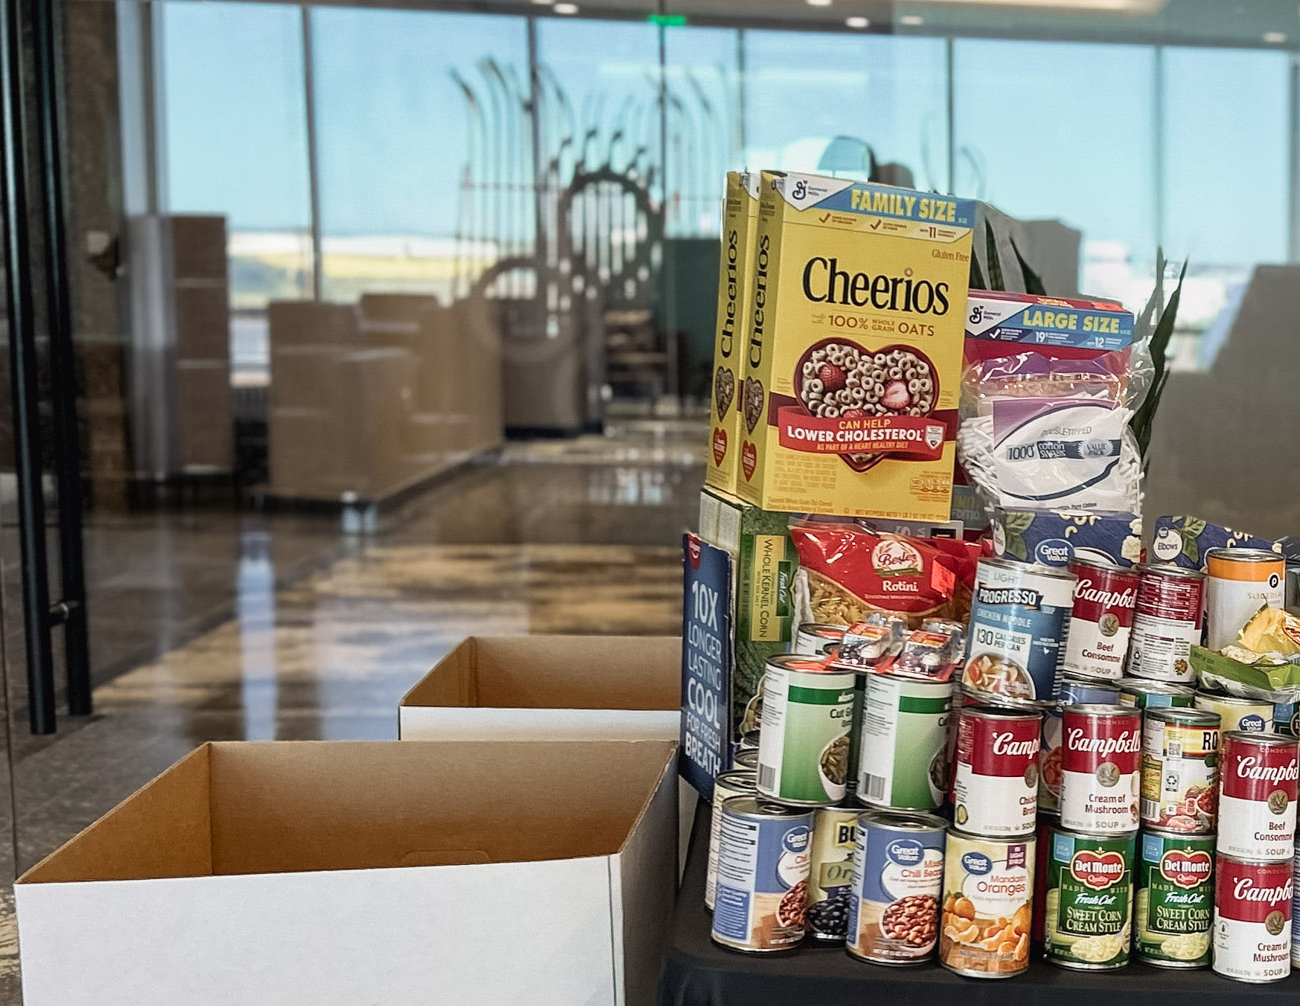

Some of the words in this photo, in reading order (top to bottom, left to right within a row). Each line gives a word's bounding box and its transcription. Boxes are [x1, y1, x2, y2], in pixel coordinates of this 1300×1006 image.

[851, 189, 915, 217] FAMILY
[919, 199, 957, 222] SIZE
[932, 249, 954, 261] Gluten
[955, 251, 969, 262] Free
[720, 229, 738, 358] Cheerios
[803, 257, 949, 316] Cheerios
[750, 233, 770, 369] Cheerios
[828, 315, 869, 330] 100%
[898, 322, 934, 337] OATS
[1023, 310, 1077, 330] LARGE
[1083, 314, 1119, 333] SIZE
[839, 420, 861, 430] CAN
[863, 419, 891, 429] HELP
[787, 426, 834, 442] LOWER
[836, 429, 924, 442] CHOLESTEROL
[762, 538, 773, 574] WHOLE
[994, 572, 1020, 583] LIGHT
[760, 575, 772, 609] KERNEL
[882, 580, 918, 592] Rotini
[978, 588, 1037, 605] PROGRESSO
[692, 580, 719, 632] 10X
[759, 611, 770, 638] CORN
[688, 621, 721, 664] LONGER
[976, 628, 994, 645] 130
[688, 654, 721, 691] LASTING
[687, 677, 721, 729] COOL
[685, 732, 721, 777] BREATH
[1089, 794, 1115, 803] Cream
[1116, 793, 1125, 803] of
[1085, 804, 1129, 815] Mushroom
[1095, 820, 1119, 829] SOUP
[1074, 860, 1091, 872] Del
[1092, 861, 1122, 873] Monte
[1164, 860, 1181, 872] Del
[1182, 861, 1210, 873] Monte
[977, 882, 1026, 894] Oranges
[1066, 908, 1096, 922] SWEET
[1098, 910, 1122, 922] CORN
[1156, 907, 1186, 921] SWEET
[1187, 908, 1210, 921] CORN
[1066, 919, 1097, 931] CREAM
[1098, 919, 1121, 932] STYLE
[1156, 918, 1187, 930] CREAM
[1187, 919, 1209, 931] STYLE
[1257, 941, 1280, 952] Cream
[1253, 951, 1289, 963] Mushroom
[1263, 968, 1284, 977] SOUP
